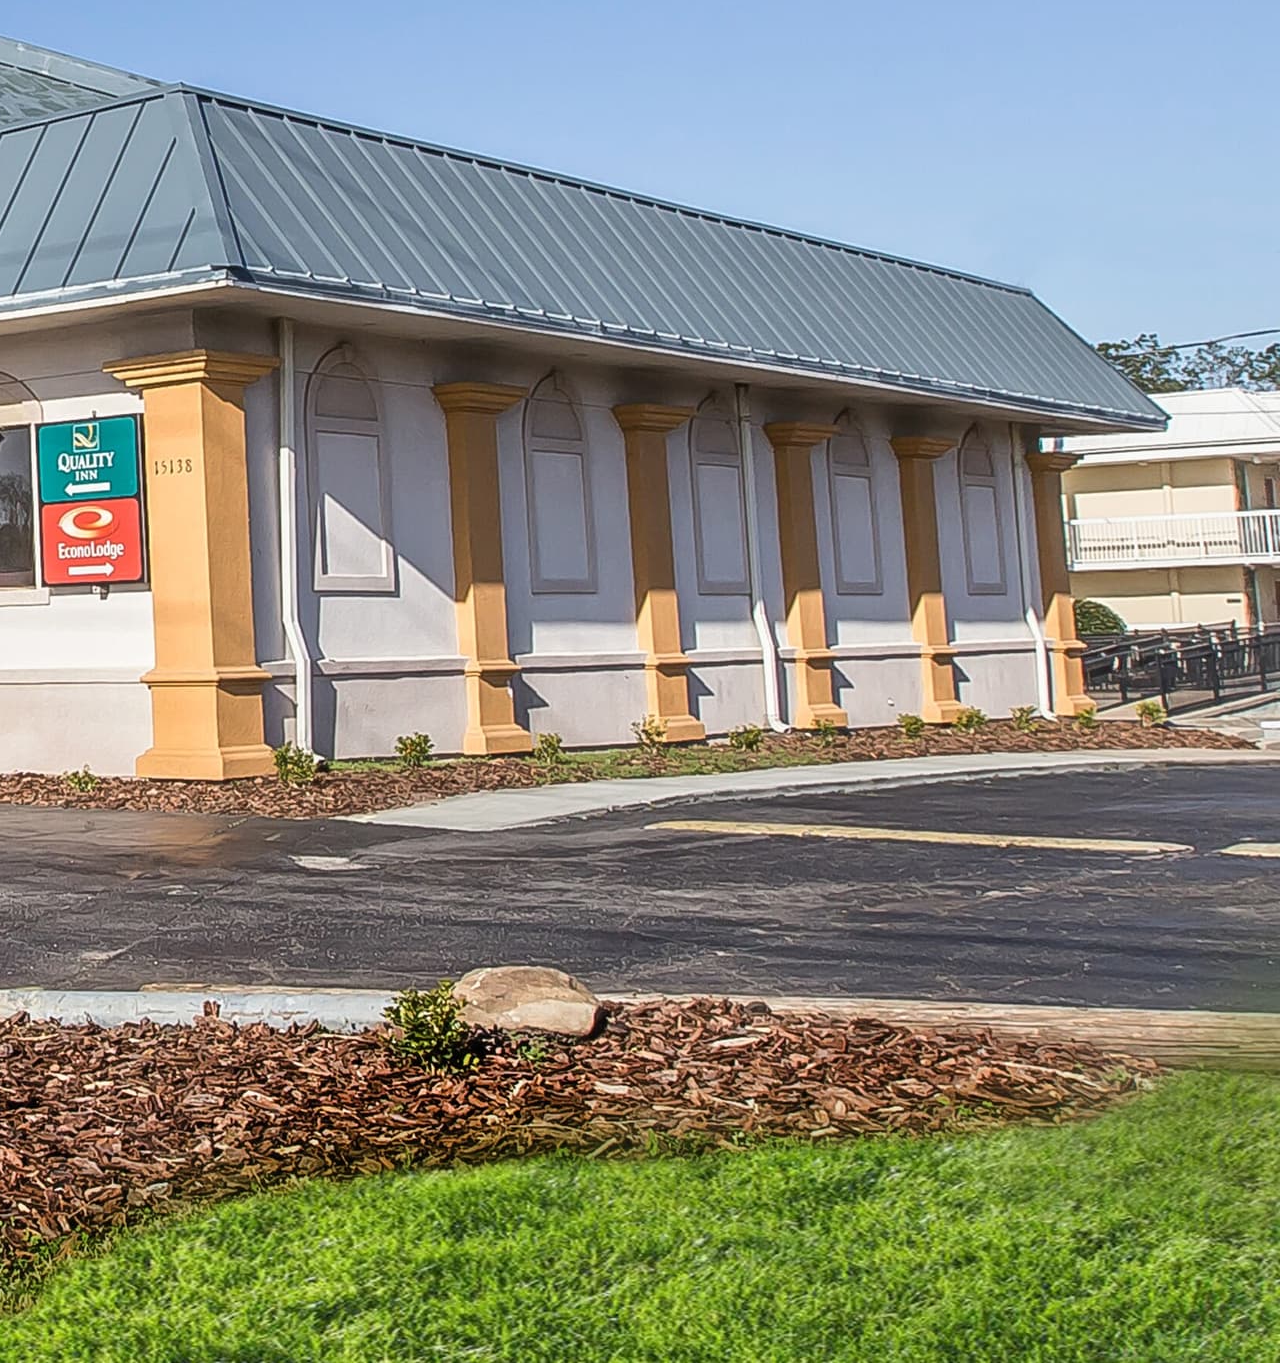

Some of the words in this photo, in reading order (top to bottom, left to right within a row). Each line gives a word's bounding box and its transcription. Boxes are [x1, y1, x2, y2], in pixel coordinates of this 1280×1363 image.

[57, 451, 115, 473] QUALITY
[154, 459, 193, 476] 15138
[75, 470, 98, 481] INN
[57, 541, 125, 560] EconoLodge
